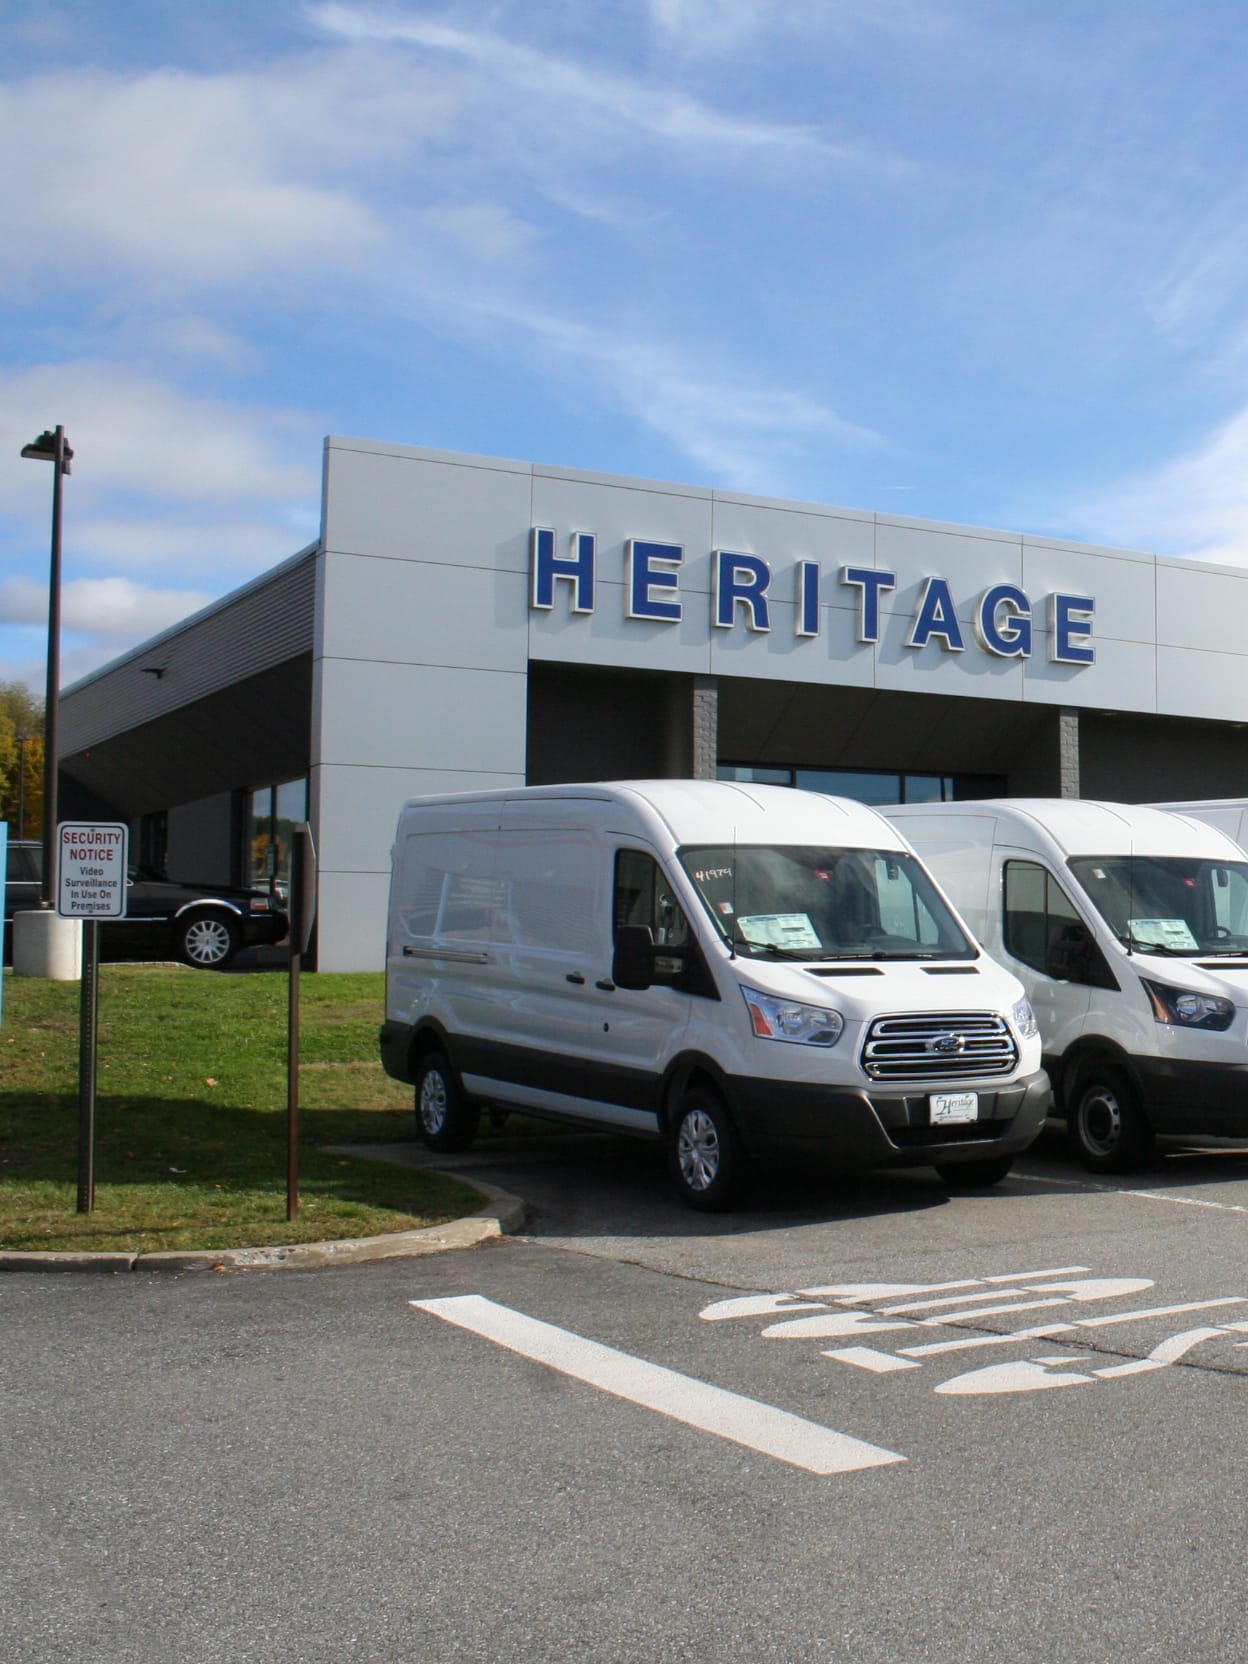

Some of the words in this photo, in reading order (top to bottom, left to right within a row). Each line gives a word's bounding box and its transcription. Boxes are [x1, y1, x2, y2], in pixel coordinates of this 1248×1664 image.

[532, 527, 1096, 665] HERITAGE
[63, 832, 121, 845] SECURITY
[70, 849, 113, 861] NOTICE
[80, 866, 104, 876] Video
[65, 878, 118, 888] Surveillance
[71, 890, 79, 899] In
[81, 890, 97, 899] Use
[100, 890, 111, 899] On
[71, 901, 111, 911] Premises
